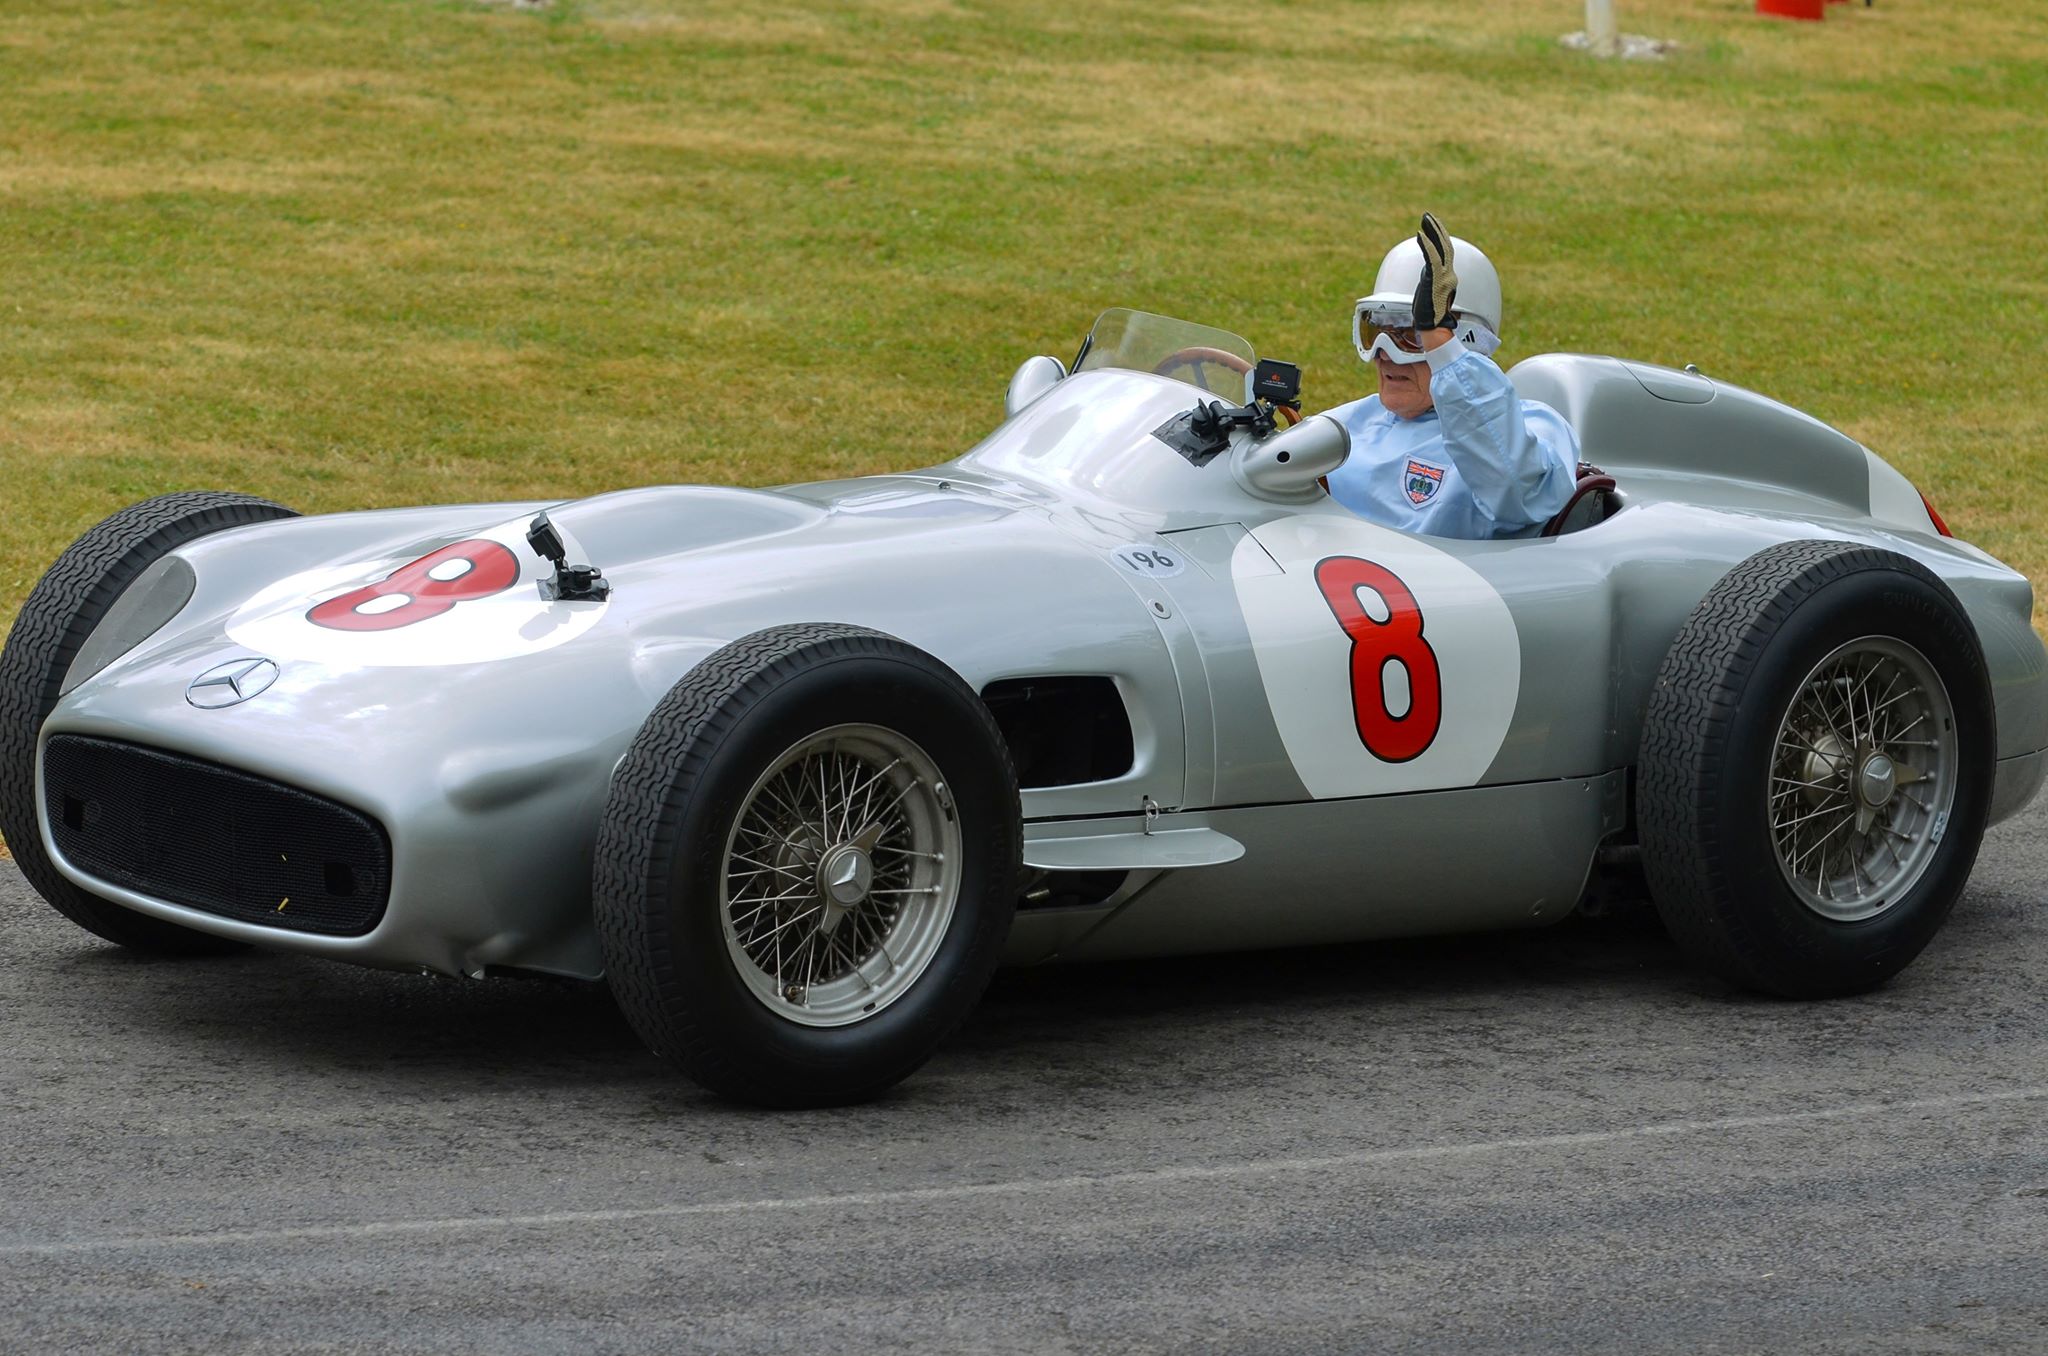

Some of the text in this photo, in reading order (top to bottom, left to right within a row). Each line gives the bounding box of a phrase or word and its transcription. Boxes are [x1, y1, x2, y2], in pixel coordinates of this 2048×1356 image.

[306, 538, 520, 632] 8
[1117, 550, 1174, 571] 196
[1314, 555, 1442, 763] 8
